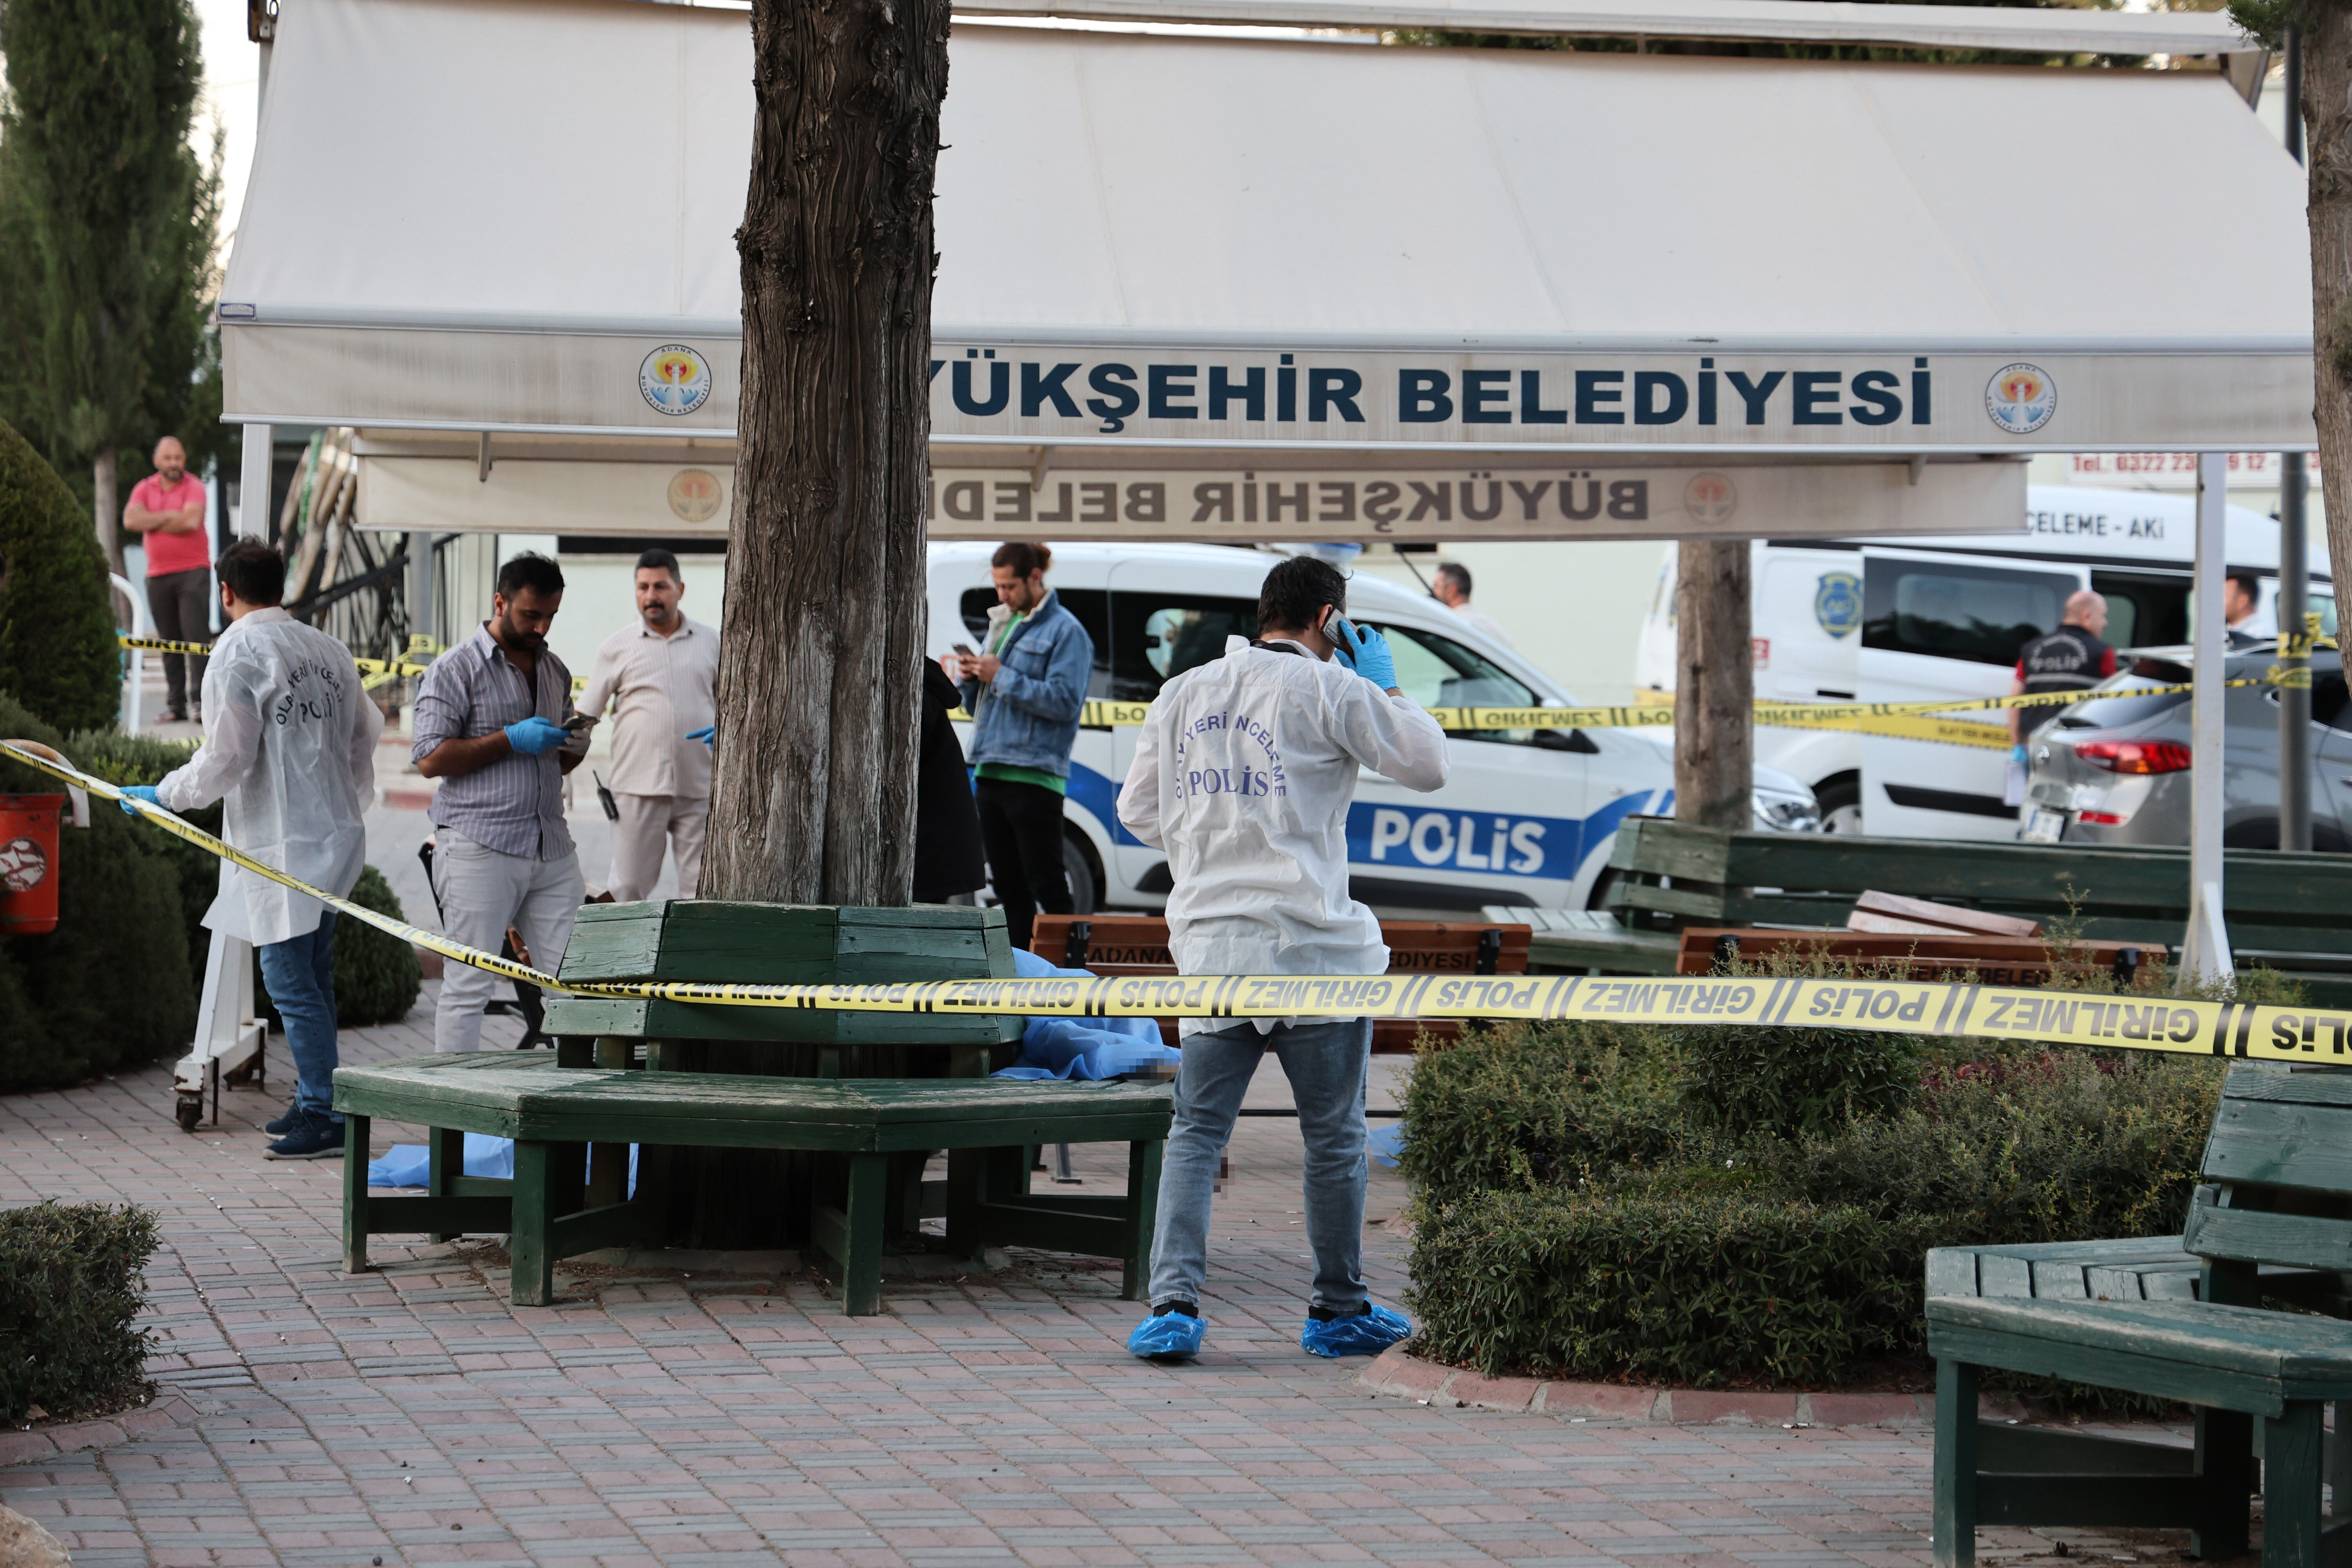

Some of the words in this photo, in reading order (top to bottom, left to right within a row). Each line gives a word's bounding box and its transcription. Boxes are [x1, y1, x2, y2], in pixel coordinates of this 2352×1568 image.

[661, 347, 691, 355] ADANA
[930, 348, 1366, 433] ÜKŞEHİR
[1399, 357, 1931, 425] BELEDİYESİ
[2026, 512, 2108, 536] CELEME
[1185, 711, 1227, 740] YERİ
[1235, 715, 1286, 797] NCELEME
[1188, 766, 1269, 797] POLİS
[1370, 809, 1546, 874] POLİS
[1089, 947, 1172, 964] ADANA
[944, 981, 1079, 1008] GİRİLMEZ
[1120, 980, 1208, 1008] POLİS
[1244, 980, 1392, 1008] GİRİLMEZ
[1437, 981, 1540, 1008] POLİS
[1581, 983, 1755, 1014] GİRİLMEZ
[1809, 987, 1930, 1022] POLİS
[1984, 996, 2200, 1043] GİRİLMEZ
[2272, 1014, 2352, 1054] LİS
